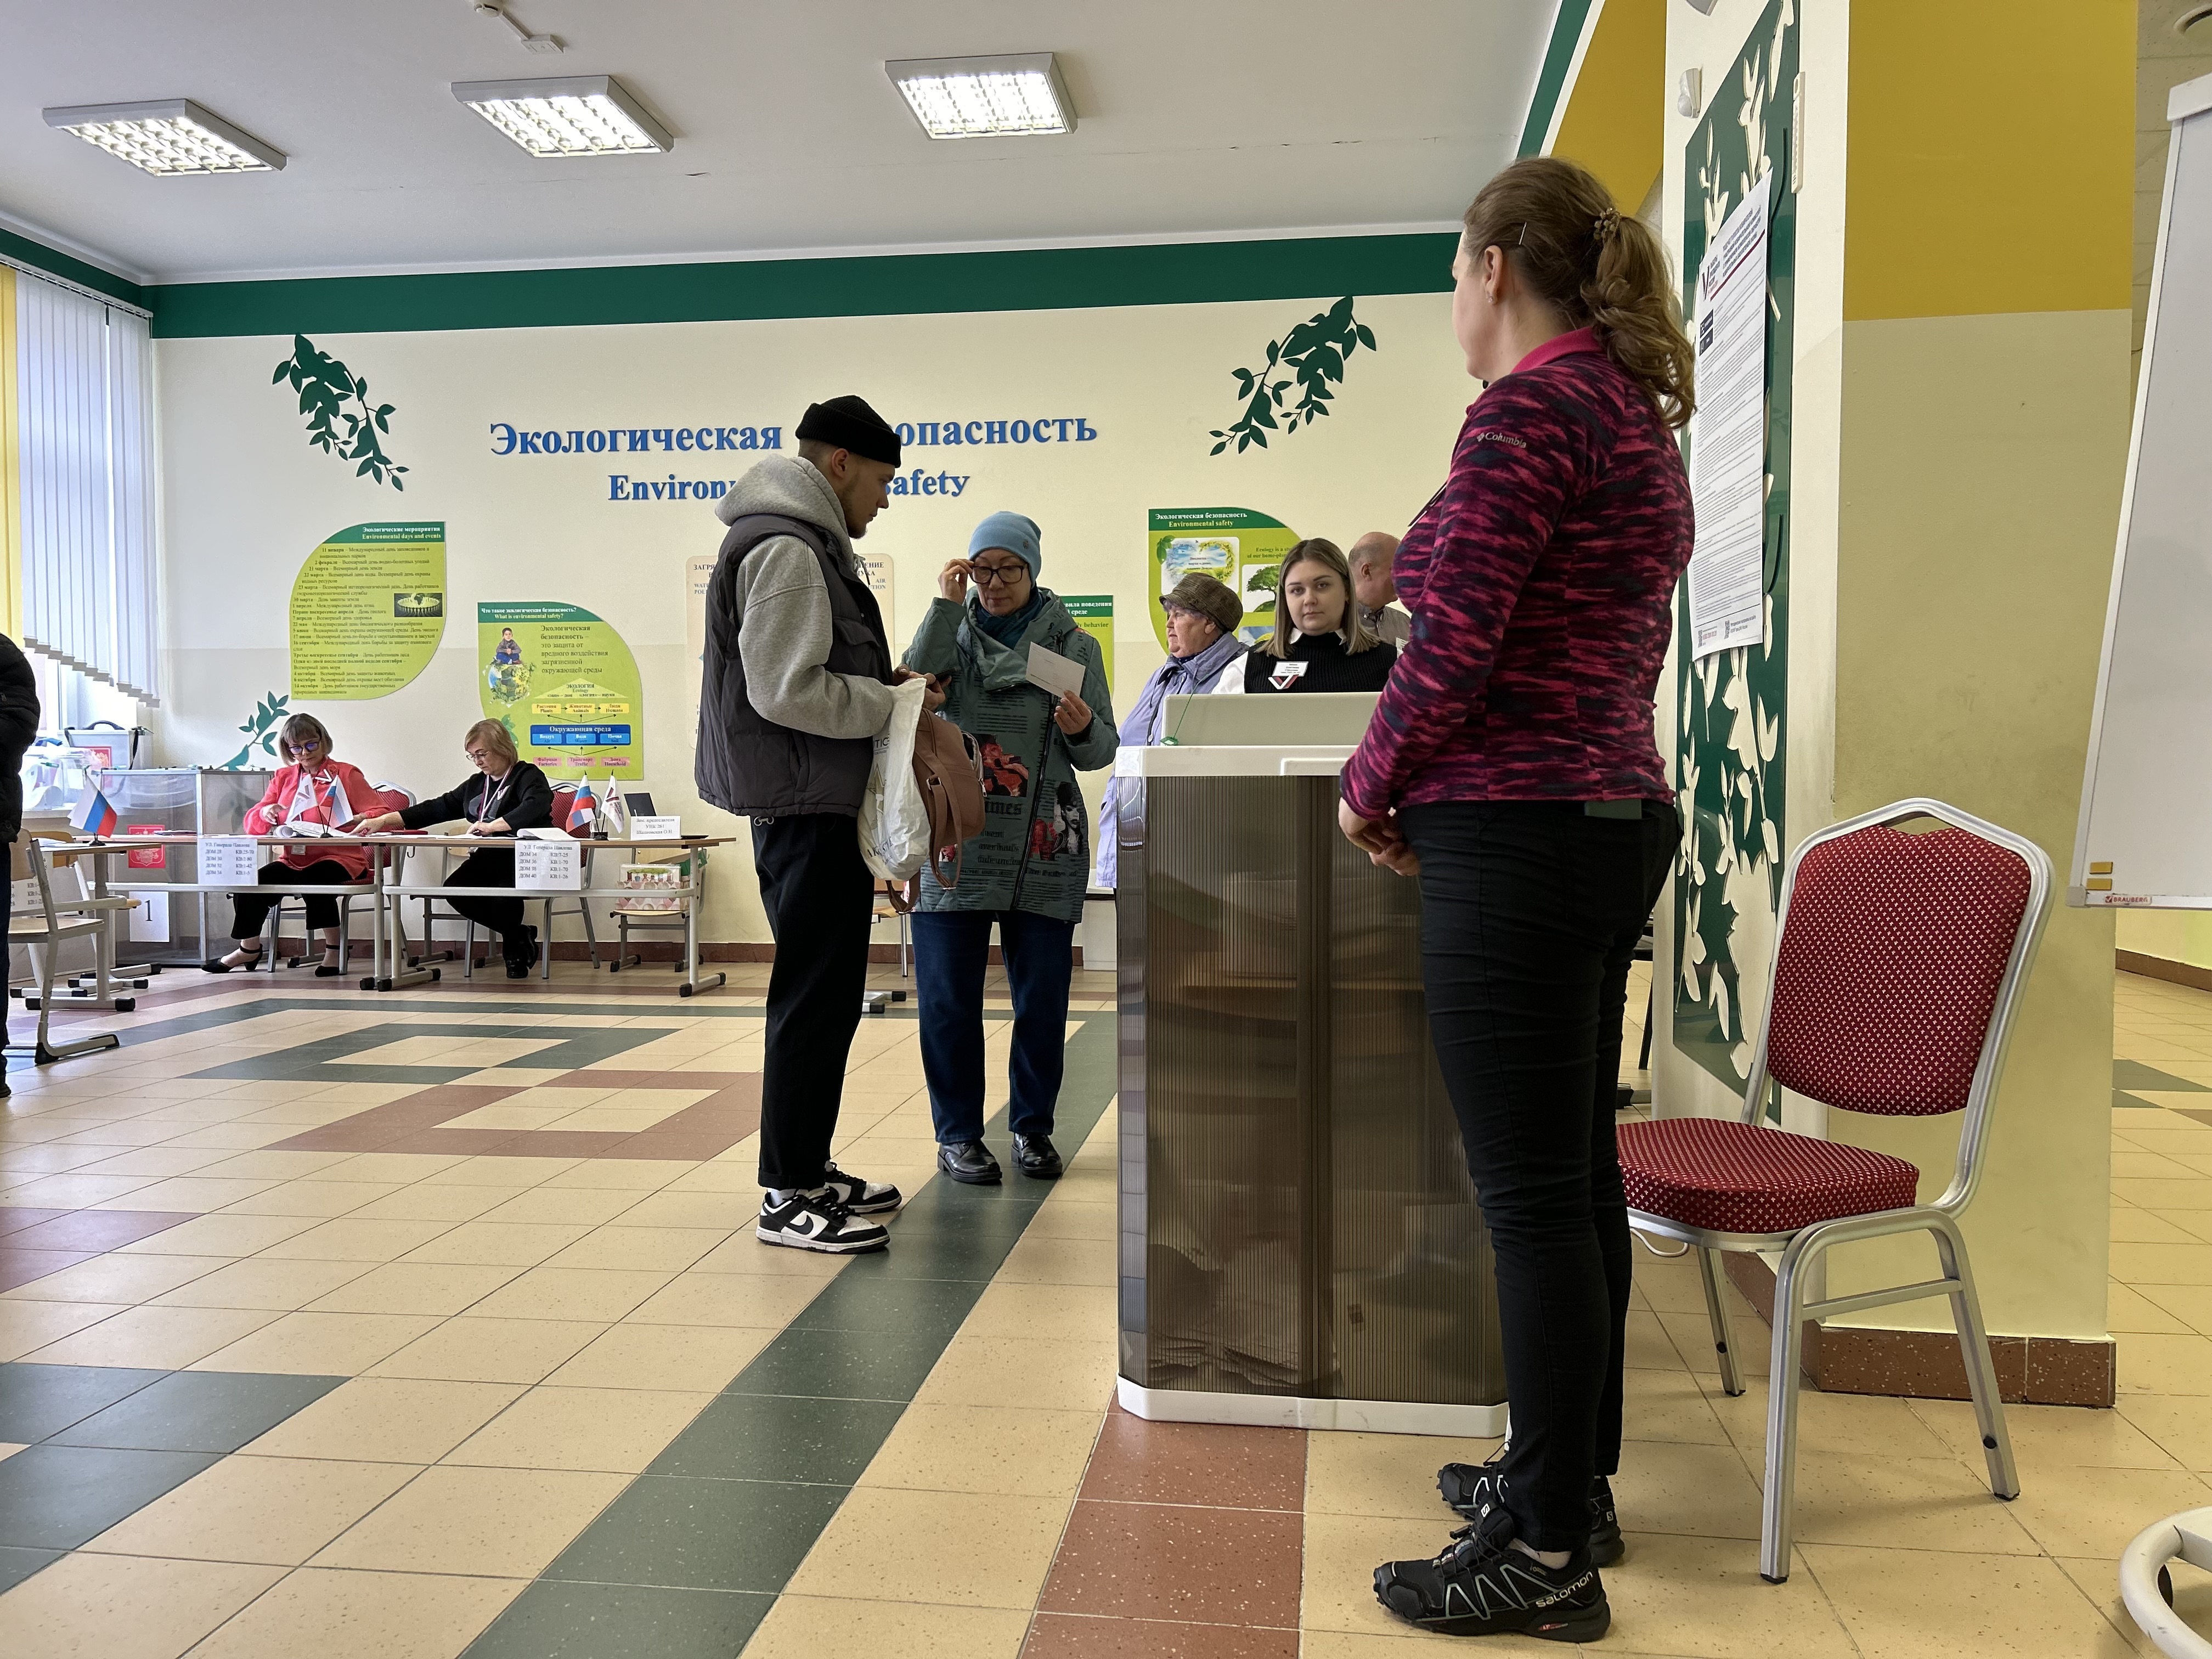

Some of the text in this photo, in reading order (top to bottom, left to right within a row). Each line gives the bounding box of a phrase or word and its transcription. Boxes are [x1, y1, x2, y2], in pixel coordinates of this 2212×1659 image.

[490, 418, 1097, 455] Экологическая опасность
[1485, 432, 1527, 448] Columbia
[608, 474, 736, 500] Environ
[145, 899, 153, 922] 1
